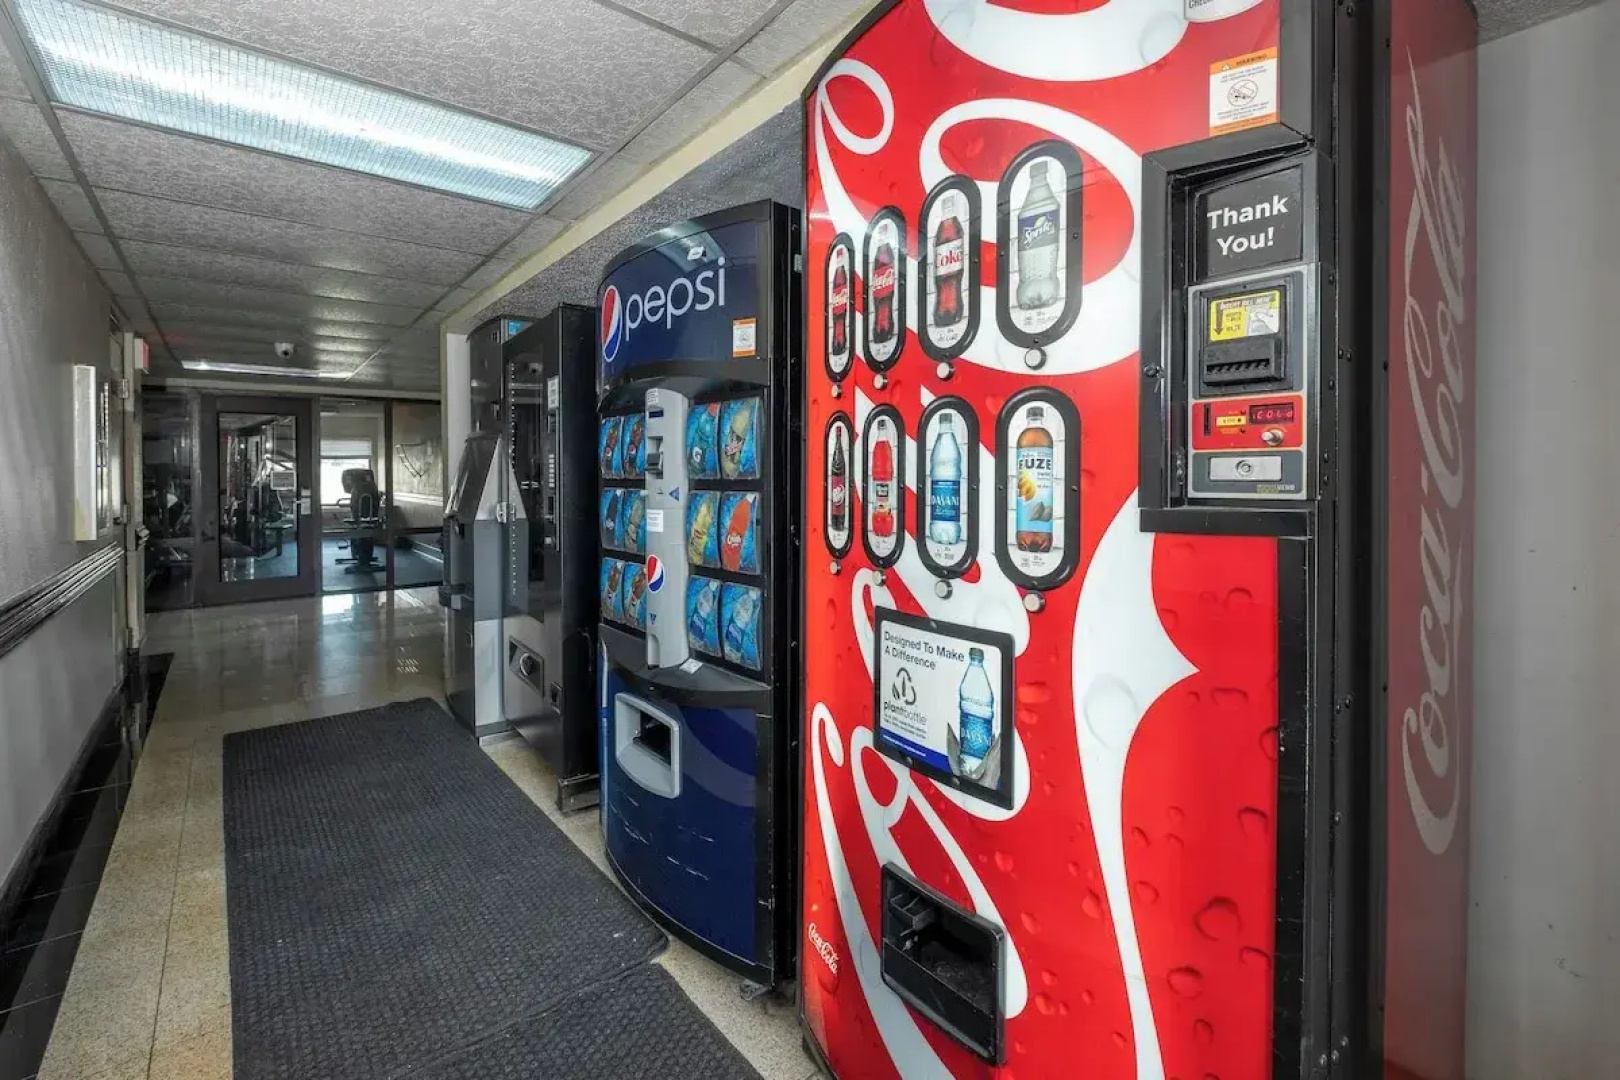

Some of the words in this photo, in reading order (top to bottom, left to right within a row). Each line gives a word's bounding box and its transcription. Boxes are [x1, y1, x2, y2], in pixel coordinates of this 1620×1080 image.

[1207, 194, 1288, 229] Thank
[1216, 226, 1274, 255] You!
[626, 256, 725, 342] pepsi
[1019, 458, 1051, 470] FUZE
[1404, 45, 1466, 854] Coca-Cola
[884, 631, 922, 651] Designed
[923, 642, 934, 654] To
[937, 645, 965, 662] Make
[885, 645, 891, 656] A
[892, 647, 937, 670] Difference
[884, 701, 927, 726] plantbottle
[808, 922, 840, 974] Coca-Cola
